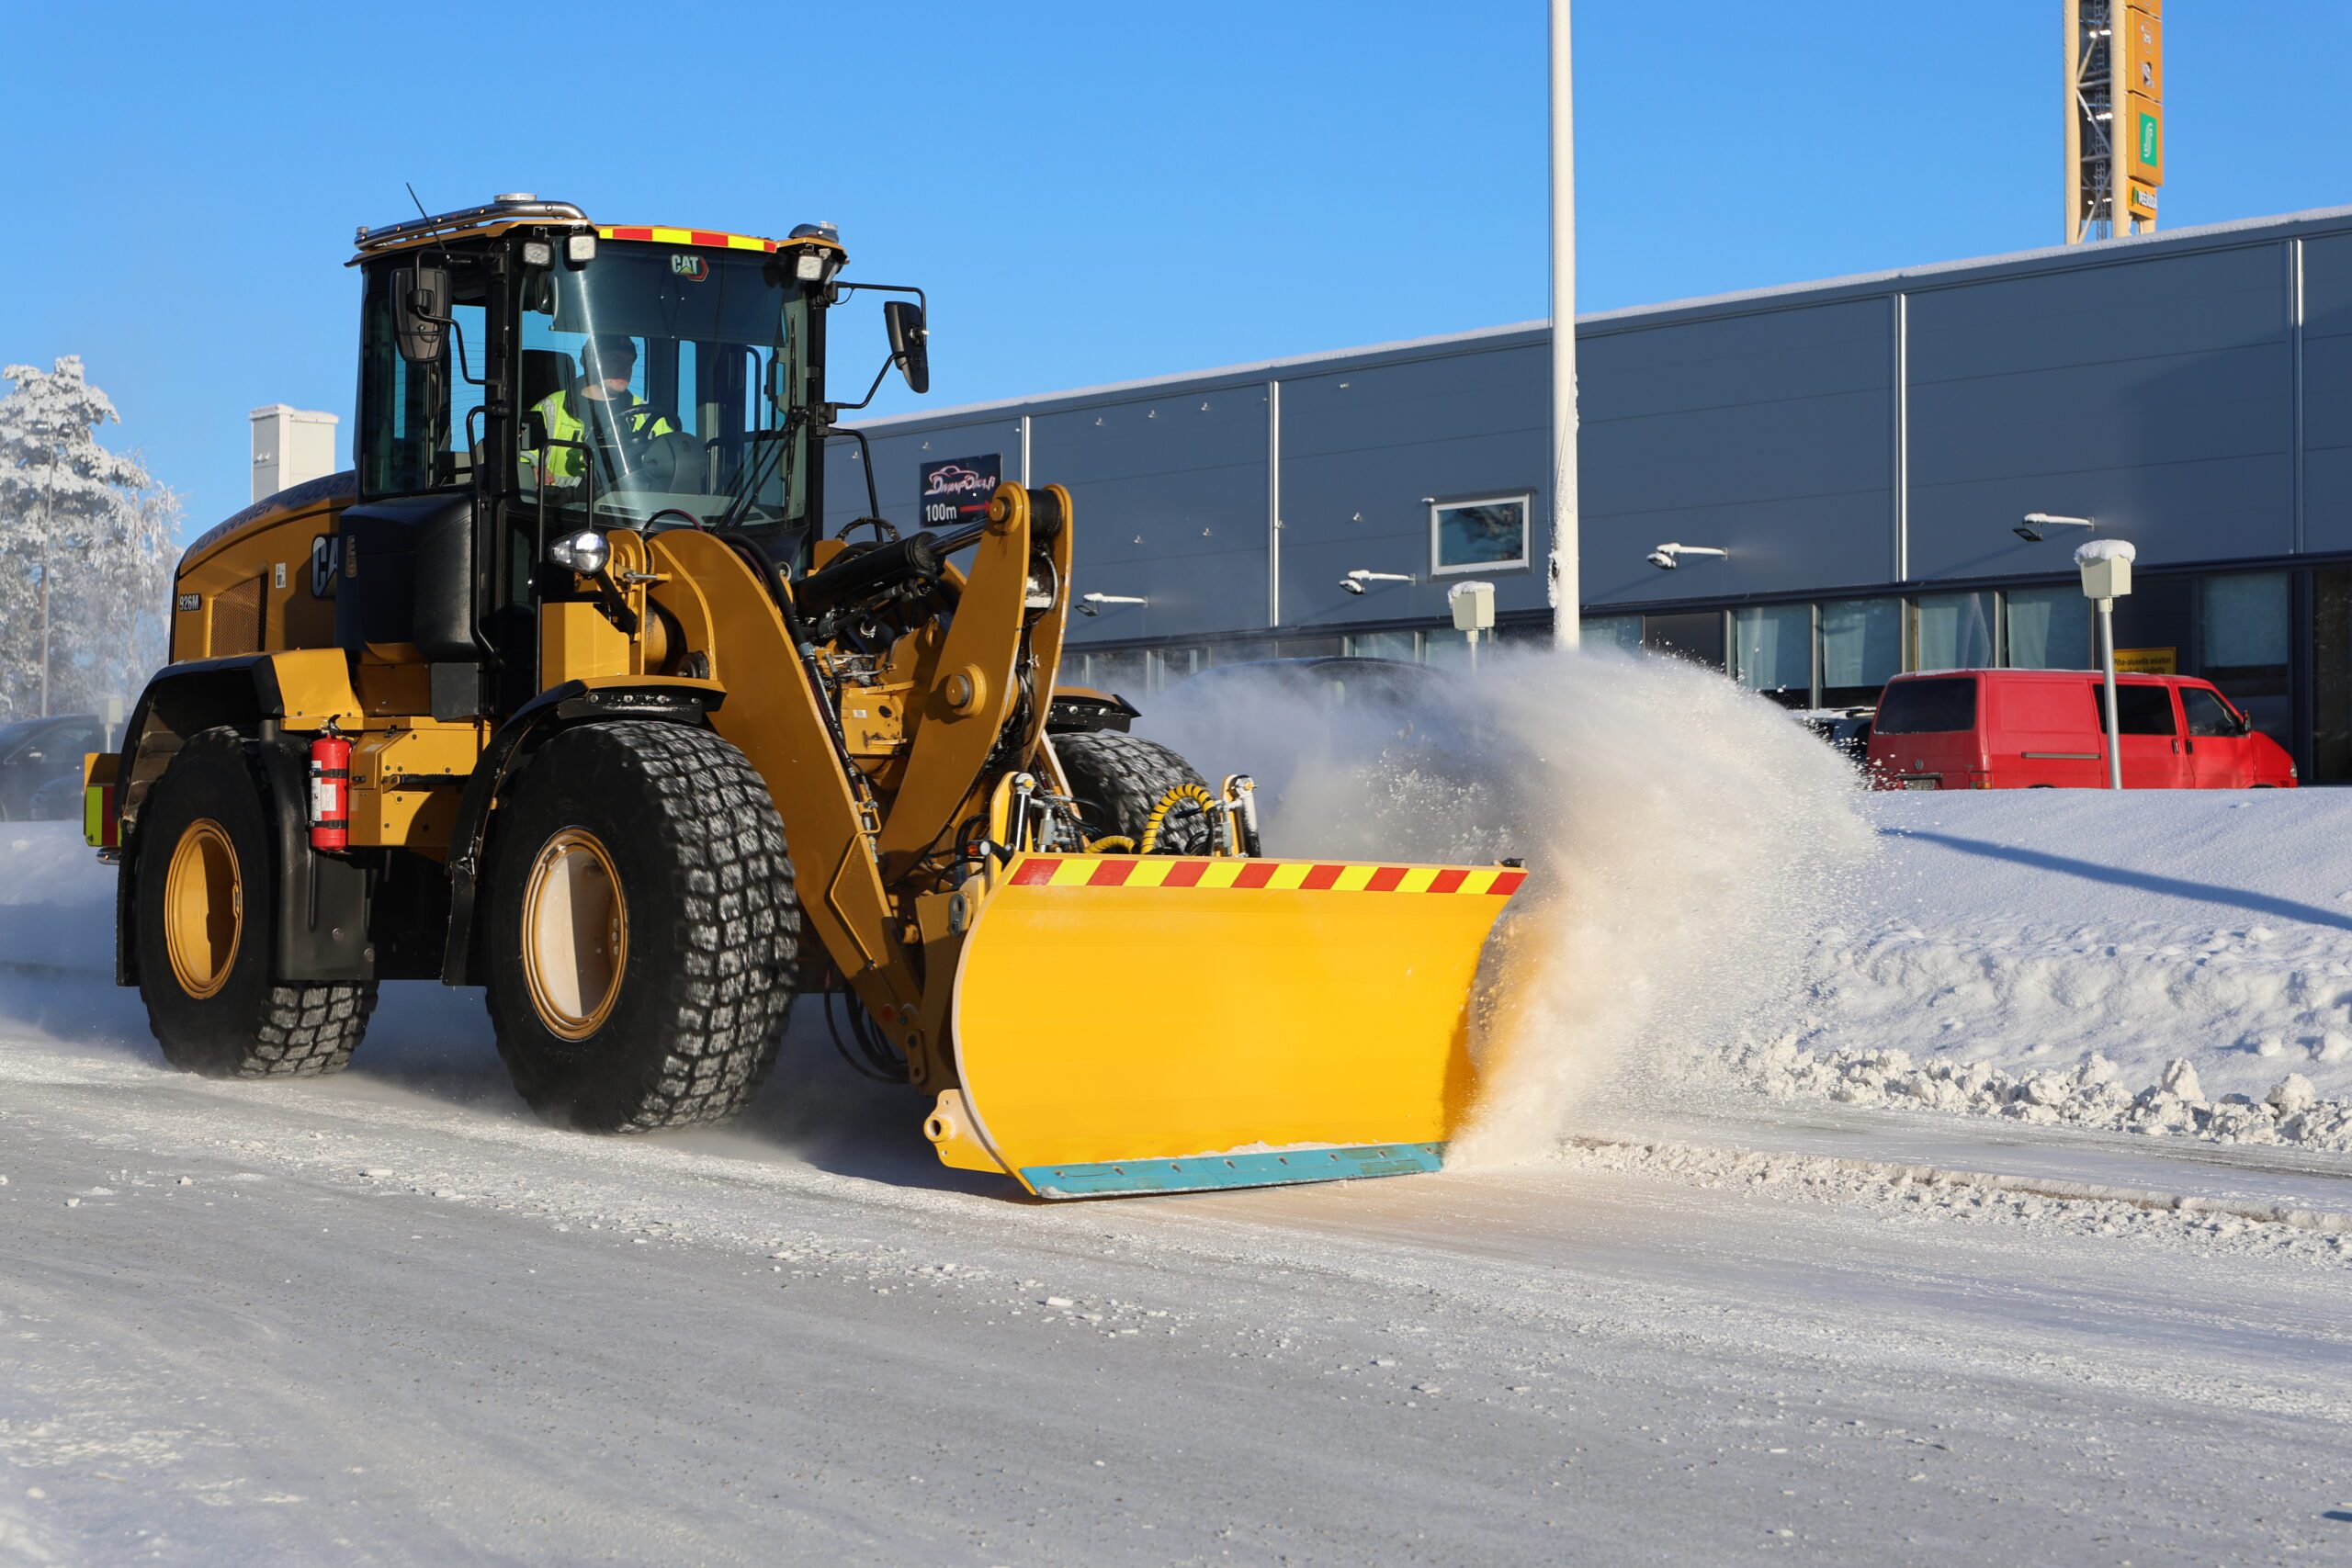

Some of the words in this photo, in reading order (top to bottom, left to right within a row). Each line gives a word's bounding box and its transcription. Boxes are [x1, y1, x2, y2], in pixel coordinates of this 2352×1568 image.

[672, 254, 698, 275] CAT
[925, 502, 957, 522] 100m
[312, 536, 339, 596] CA
[179, 594, 199, 611] 926M
